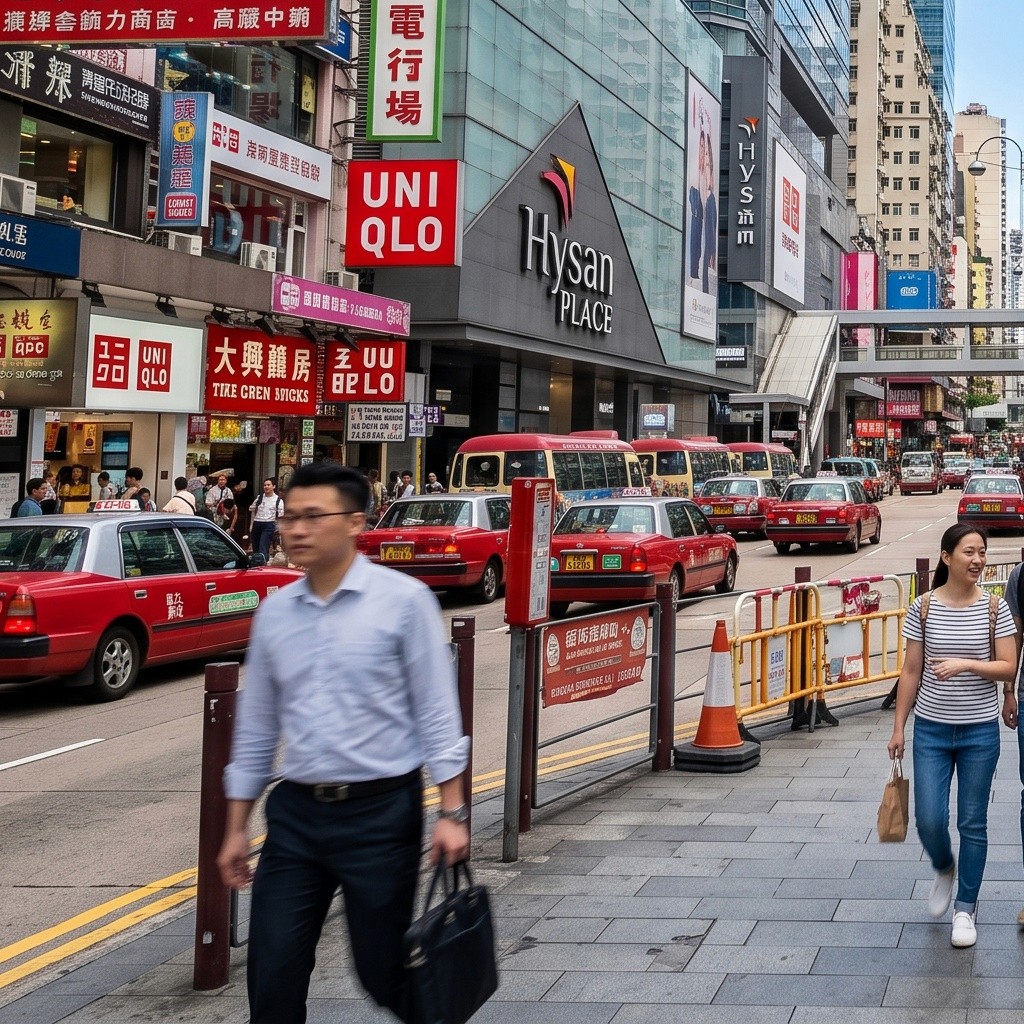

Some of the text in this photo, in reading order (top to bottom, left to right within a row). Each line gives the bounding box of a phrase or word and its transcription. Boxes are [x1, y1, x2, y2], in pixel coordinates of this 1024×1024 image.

[362, 171, 439, 208] UNI
[360, 216, 443, 260] QLO
[523, 205, 614, 296] Hysan
[559, 289, 613, 334] PLACE
[142, 346, 167, 366] UNI
[141, 367, 167, 389] QLO
[363, 372, 395, 395] LO
